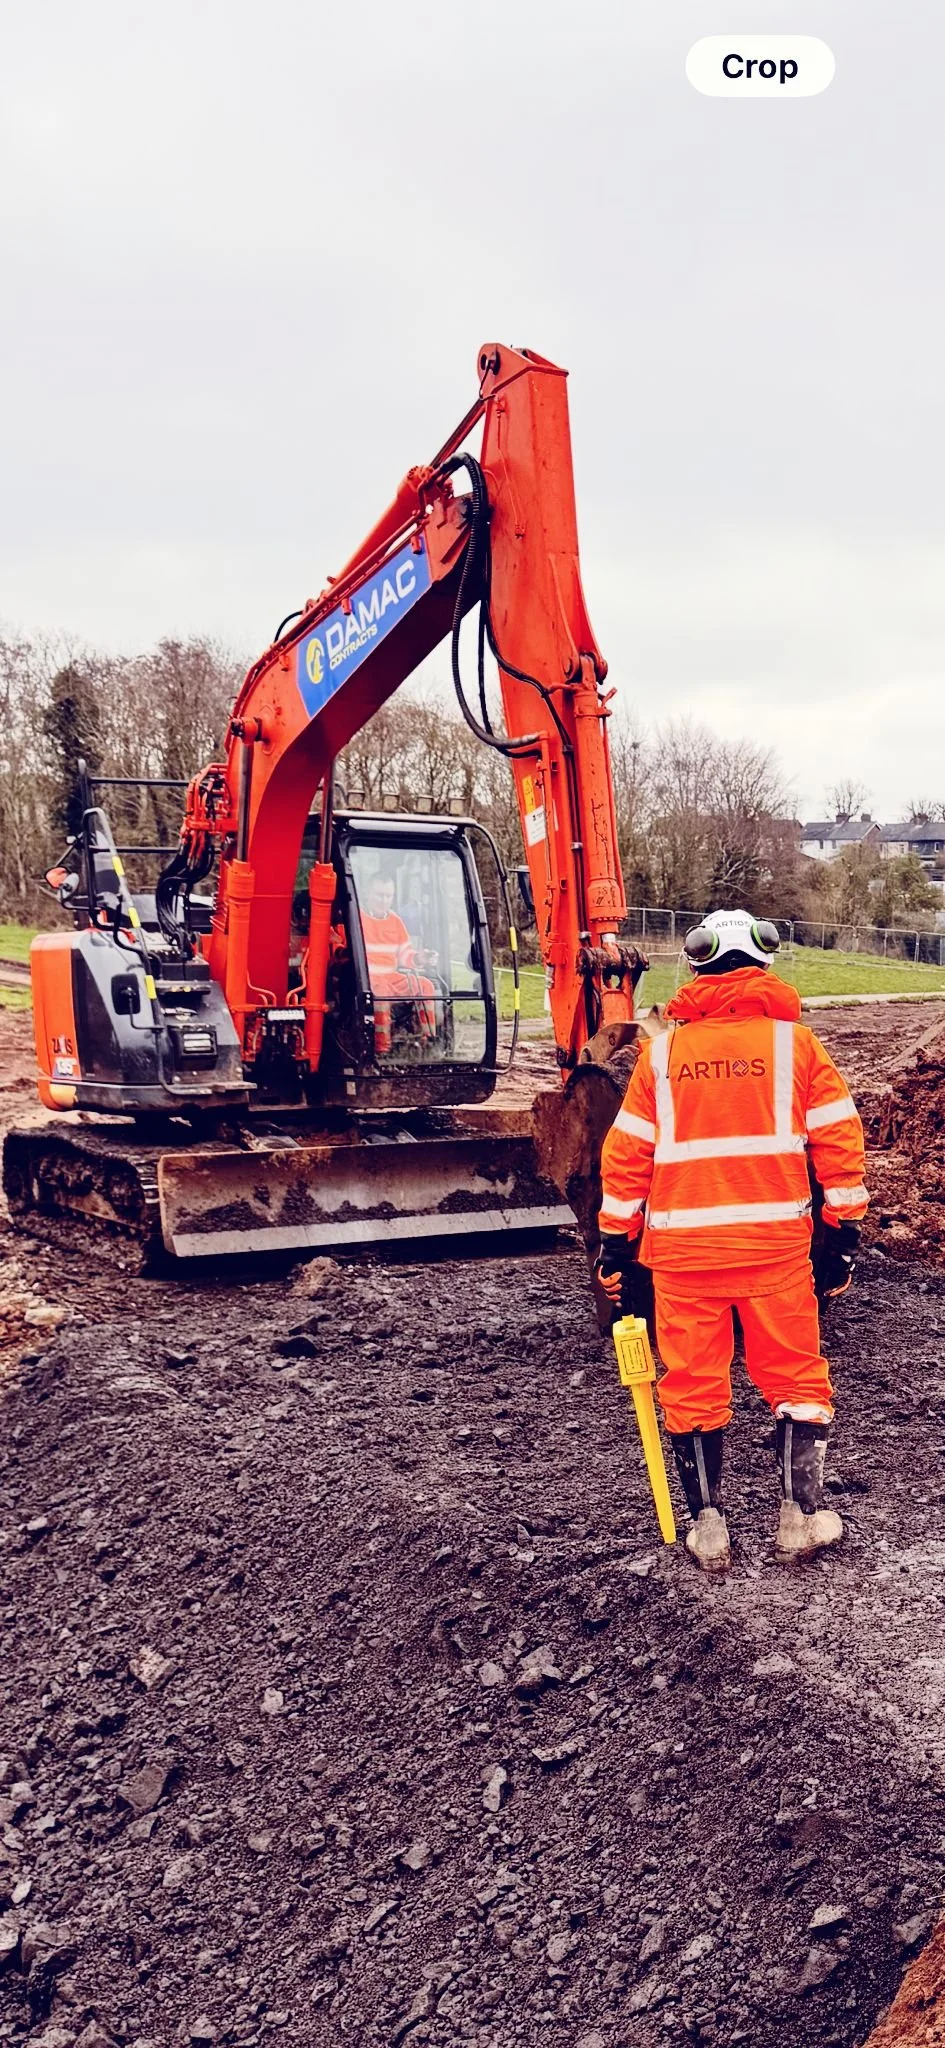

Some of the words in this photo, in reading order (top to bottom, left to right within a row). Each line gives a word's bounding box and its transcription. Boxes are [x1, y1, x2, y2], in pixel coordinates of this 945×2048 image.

[325, 559, 416, 656] DAMAC
[328, 625, 379, 669] CONTRACTS
[677, 1058, 766, 1082] ARTIOS
